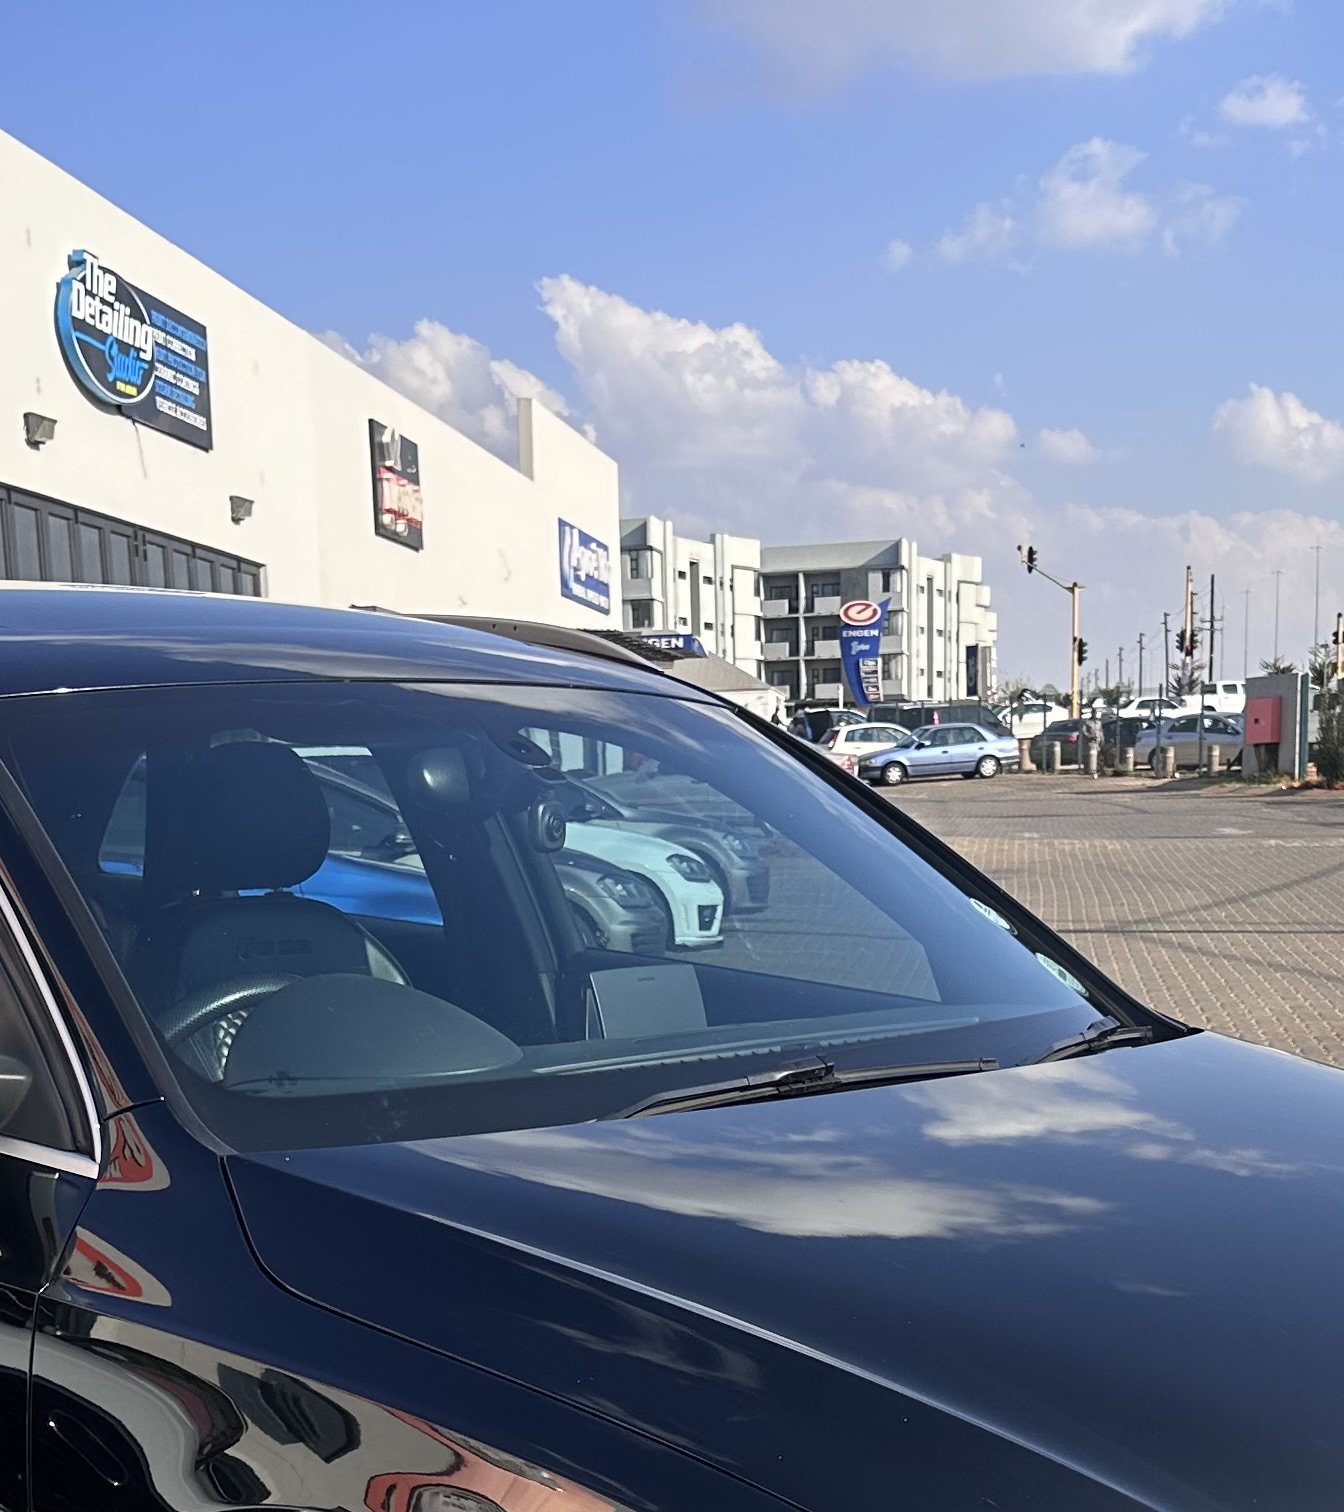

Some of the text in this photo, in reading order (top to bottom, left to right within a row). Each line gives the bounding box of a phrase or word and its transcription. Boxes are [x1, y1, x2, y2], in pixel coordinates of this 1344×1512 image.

[83, 251, 117, 304] The
[71, 279, 153, 362] Detailing
[642, 636, 685, 650] GEN
